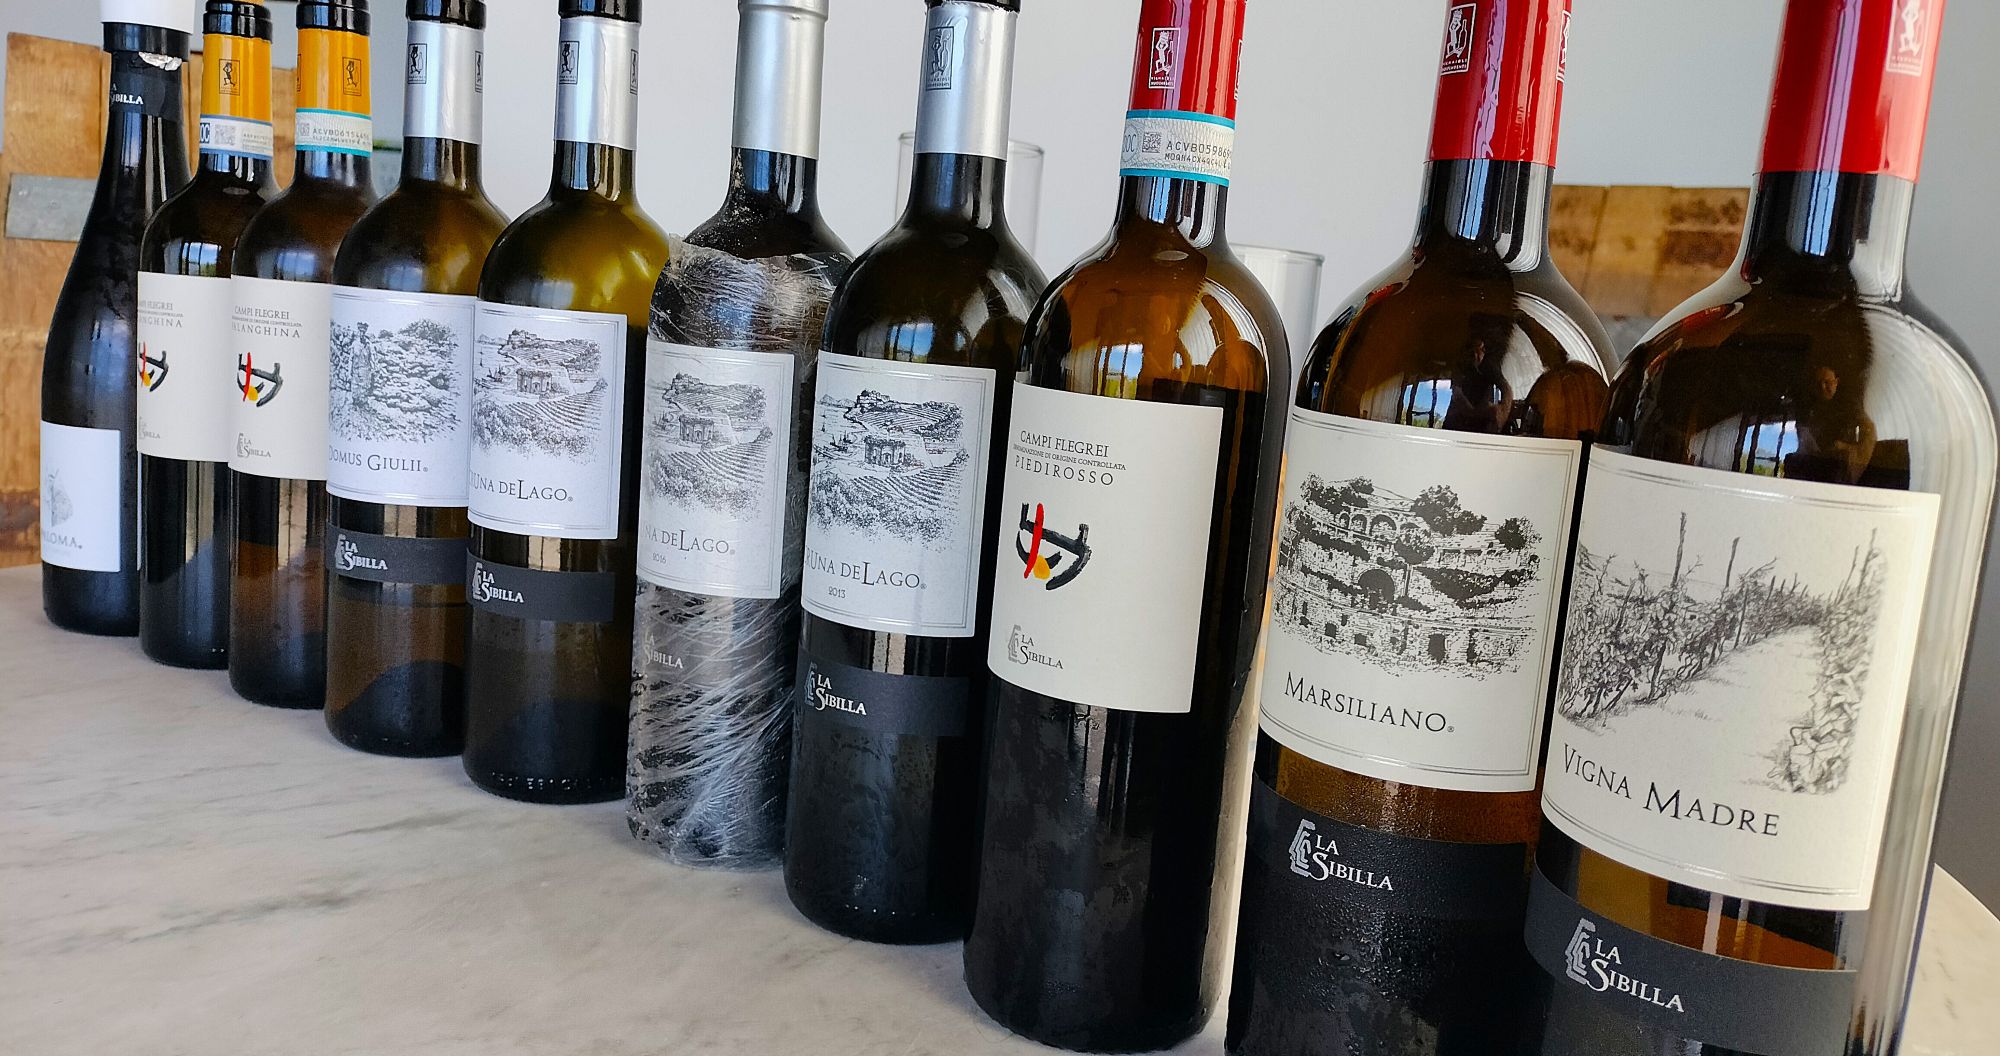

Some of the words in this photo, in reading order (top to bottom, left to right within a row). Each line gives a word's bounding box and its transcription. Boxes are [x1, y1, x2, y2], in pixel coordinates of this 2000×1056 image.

[254, 308, 289, 320] FLEGREI
[243, 445, 272, 459] SIBILLA
[1020, 430, 1053, 449] CAMPI
[1054, 437, 1109, 458] FLEGREI
[328, 445, 362, 467] DOMUS
[1044, 452, 1052, 460] DI
[1051, 453, 1077, 465] ORIGINE
[1077, 458, 1127, 472] CONTROLLATA
[1015, 455, 1114, 486] PIEDIROSSO
[345, 541, 359, 553] LA
[343, 552, 388, 571] SIBILLA
[805, 544, 836, 575] RUNA
[483, 571, 495, 584] LA
[481, 582, 525, 602] SIBILLA
[828, 586, 848, 599] 2013
[1021, 634, 1034, 647] LA
[644, 644, 684, 669] SIBILLA
[1018, 645, 1064, 670] SIBILLA
[817, 673, 833, 690] LA
[815, 688, 868, 715] SIBILLA
[1564, 743, 1632, 800] VIGNA
[1642, 782, 1780, 837] MADRE
[1315, 834, 1340, 856] LA
[1309, 851, 1394, 891] SIBILLA
[1595, 938, 1623, 965] LA
[1587, 957, 1686, 1014] SIBILLA
